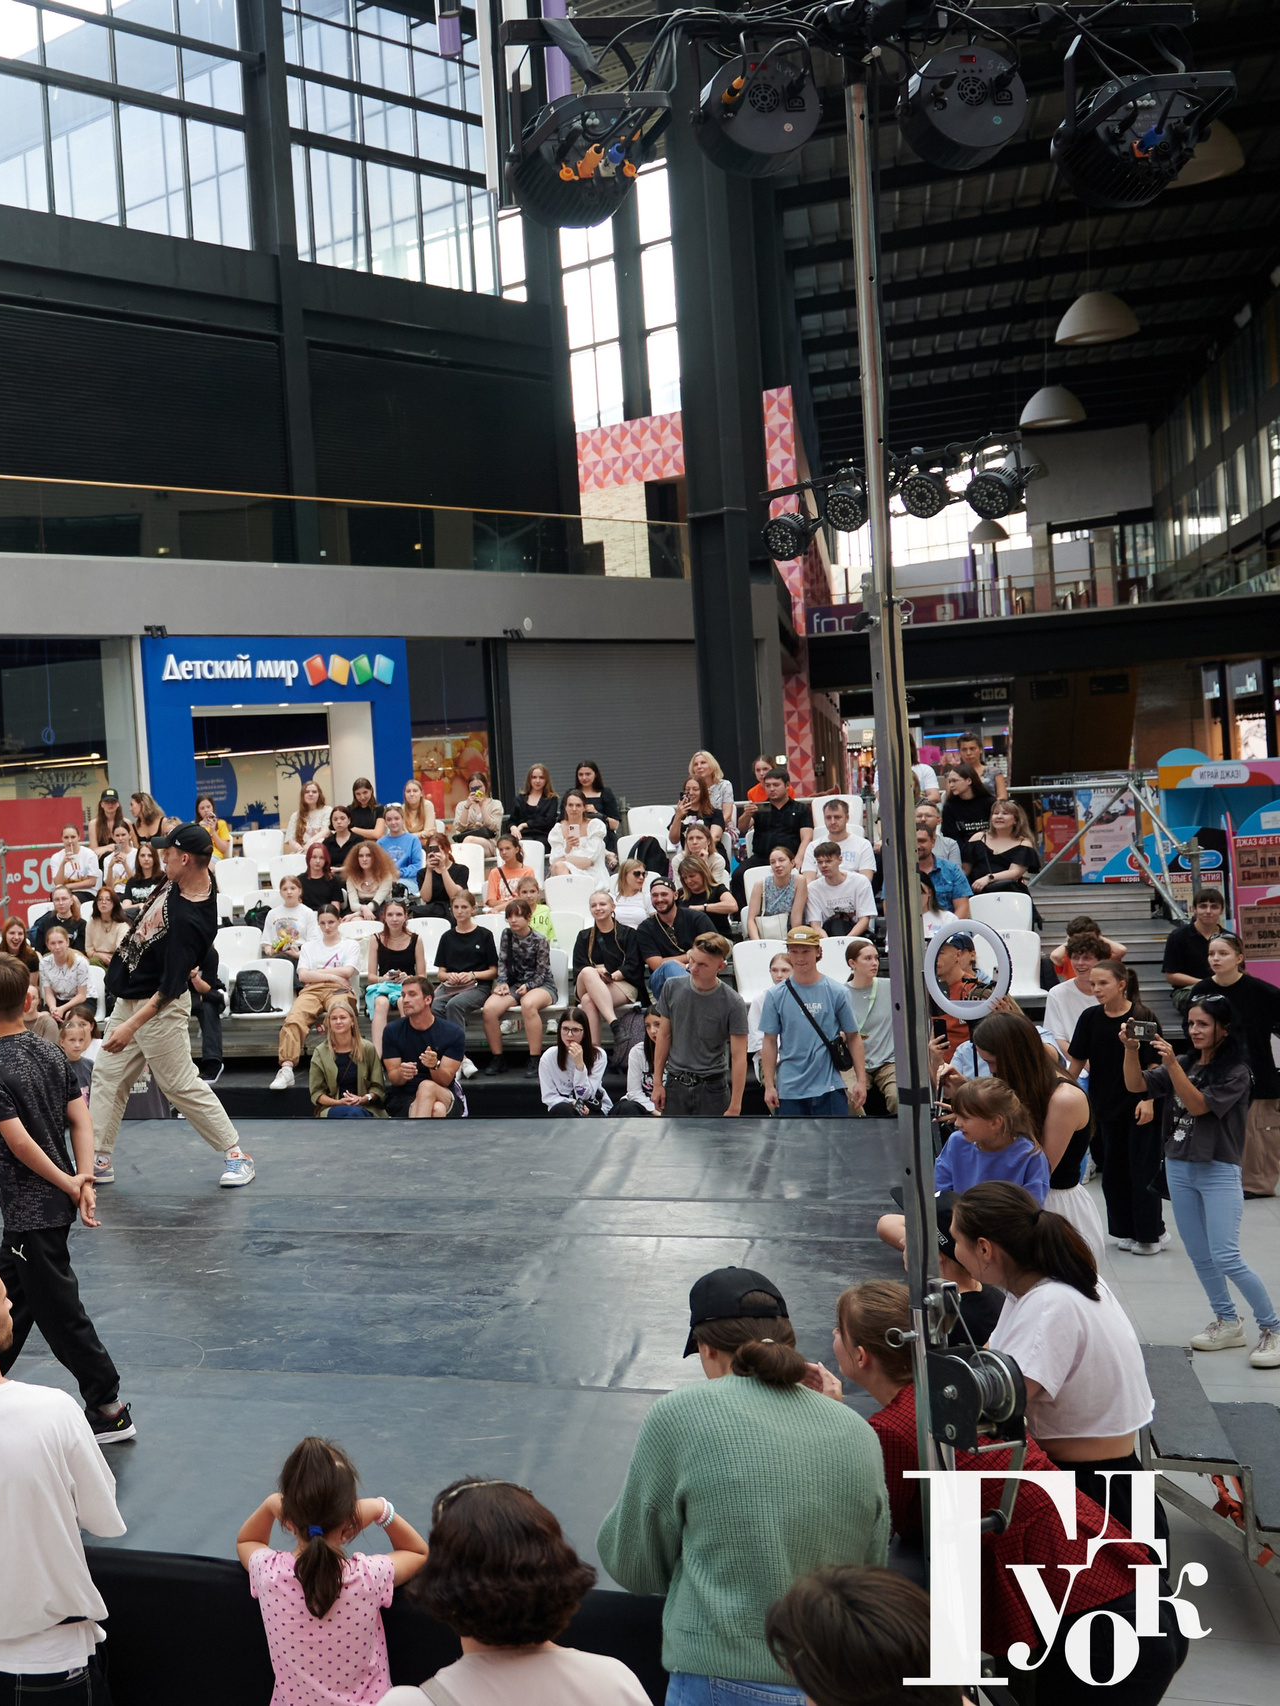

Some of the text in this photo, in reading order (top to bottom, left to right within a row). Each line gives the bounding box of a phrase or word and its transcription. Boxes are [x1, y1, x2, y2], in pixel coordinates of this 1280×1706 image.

[162, 654, 299, 686] Детский мир
[1199, 770, 1219, 780] ИГРАЙ
[1236, 838, 1258, 848] ДЖАЗ
[1259, 837, 1273, 845] 40-Е
[1188, 873, 1221, 883] СЫТИЯ
